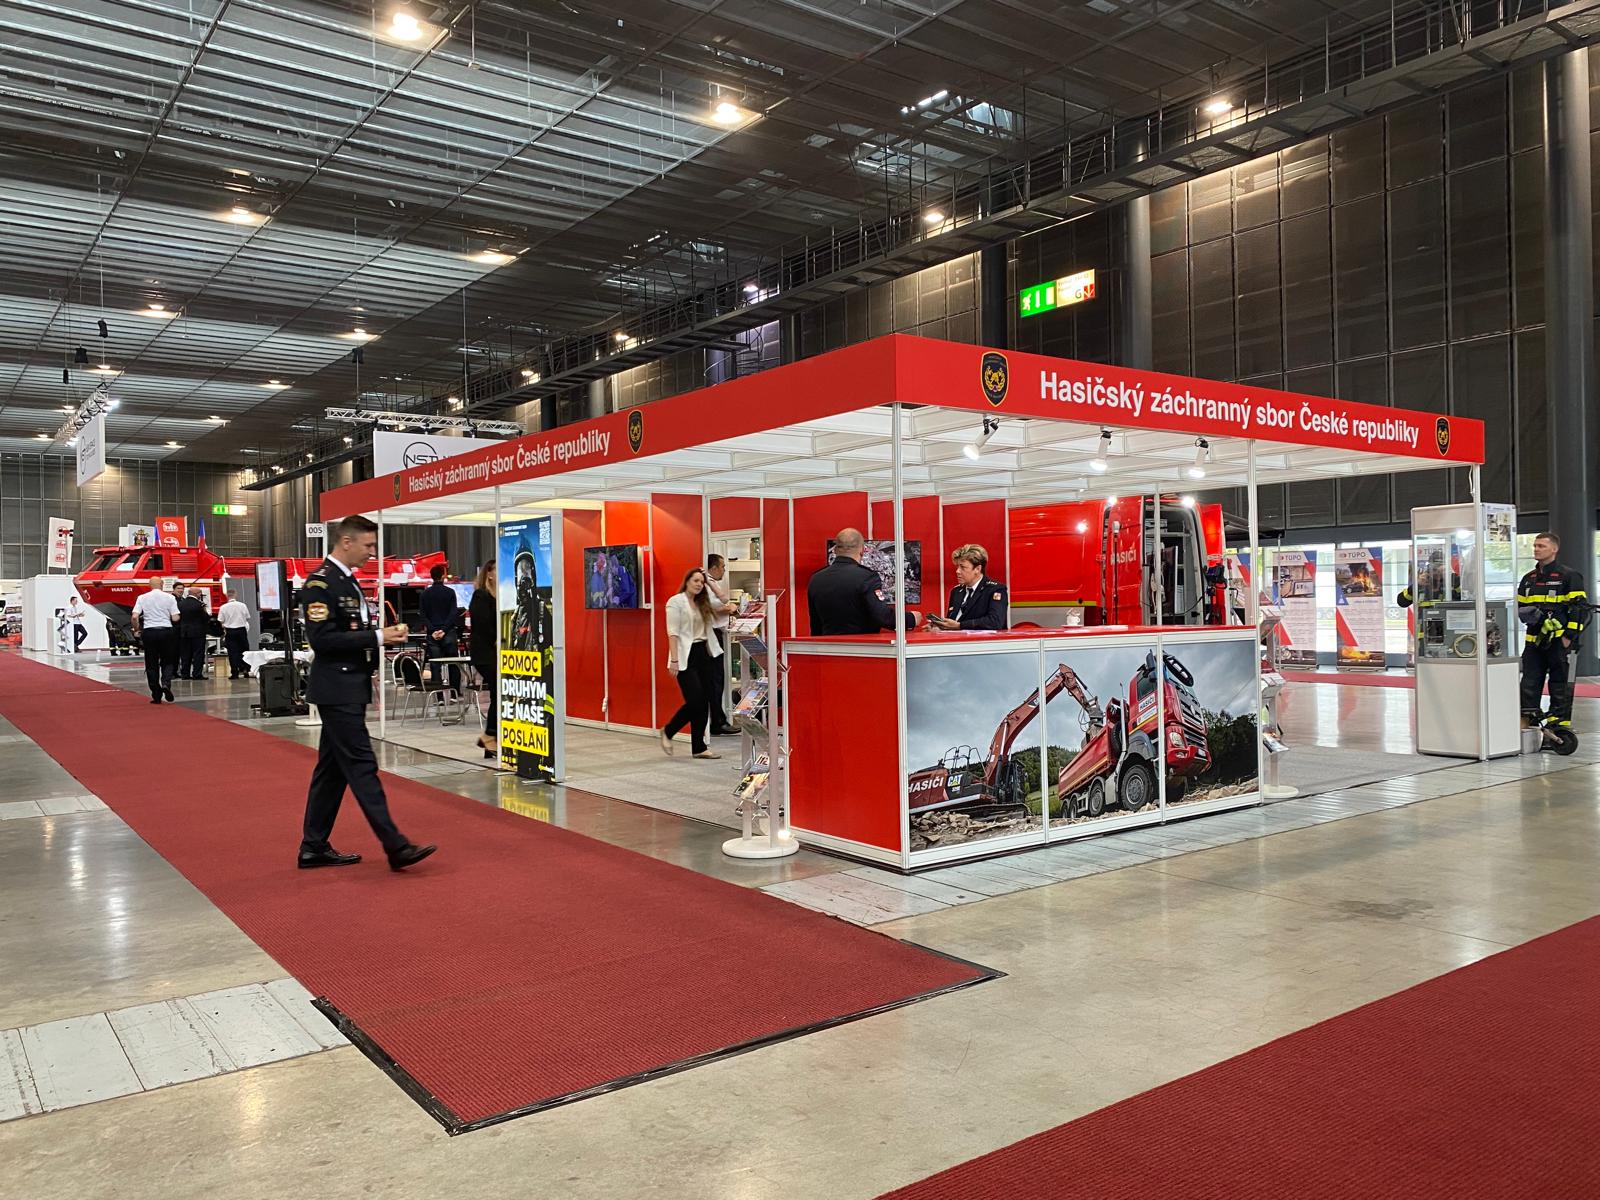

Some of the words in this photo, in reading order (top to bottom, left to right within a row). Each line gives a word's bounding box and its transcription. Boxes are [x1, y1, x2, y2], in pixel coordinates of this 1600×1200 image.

[1040, 370, 1145, 417] Hasičský
[1150, 386, 1252, 430] záchranný
[1256, 402, 1296, 429] sbor
[1299, 402, 1349, 436] České
[1352, 418, 1420, 449] republiky
[409, 467, 443, 494] Hasičský
[445, 455, 490, 485] záchranný
[491, 454, 514, 475] sbor
[516, 440, 550, 470] České
[553, 429, 611, 465] republiky
[502, 654, 539, 673] POMOC
[501, 677, 547, 701] DRUHÝM
[501, 700, 514, 719] JE
[515, 700, 545, 725] NAŠE
[503, 726, 548, 753] POSLÁNÍ
[908, 776, 944, 794] HASIČI
[947, 774, 963, 787] CAT
